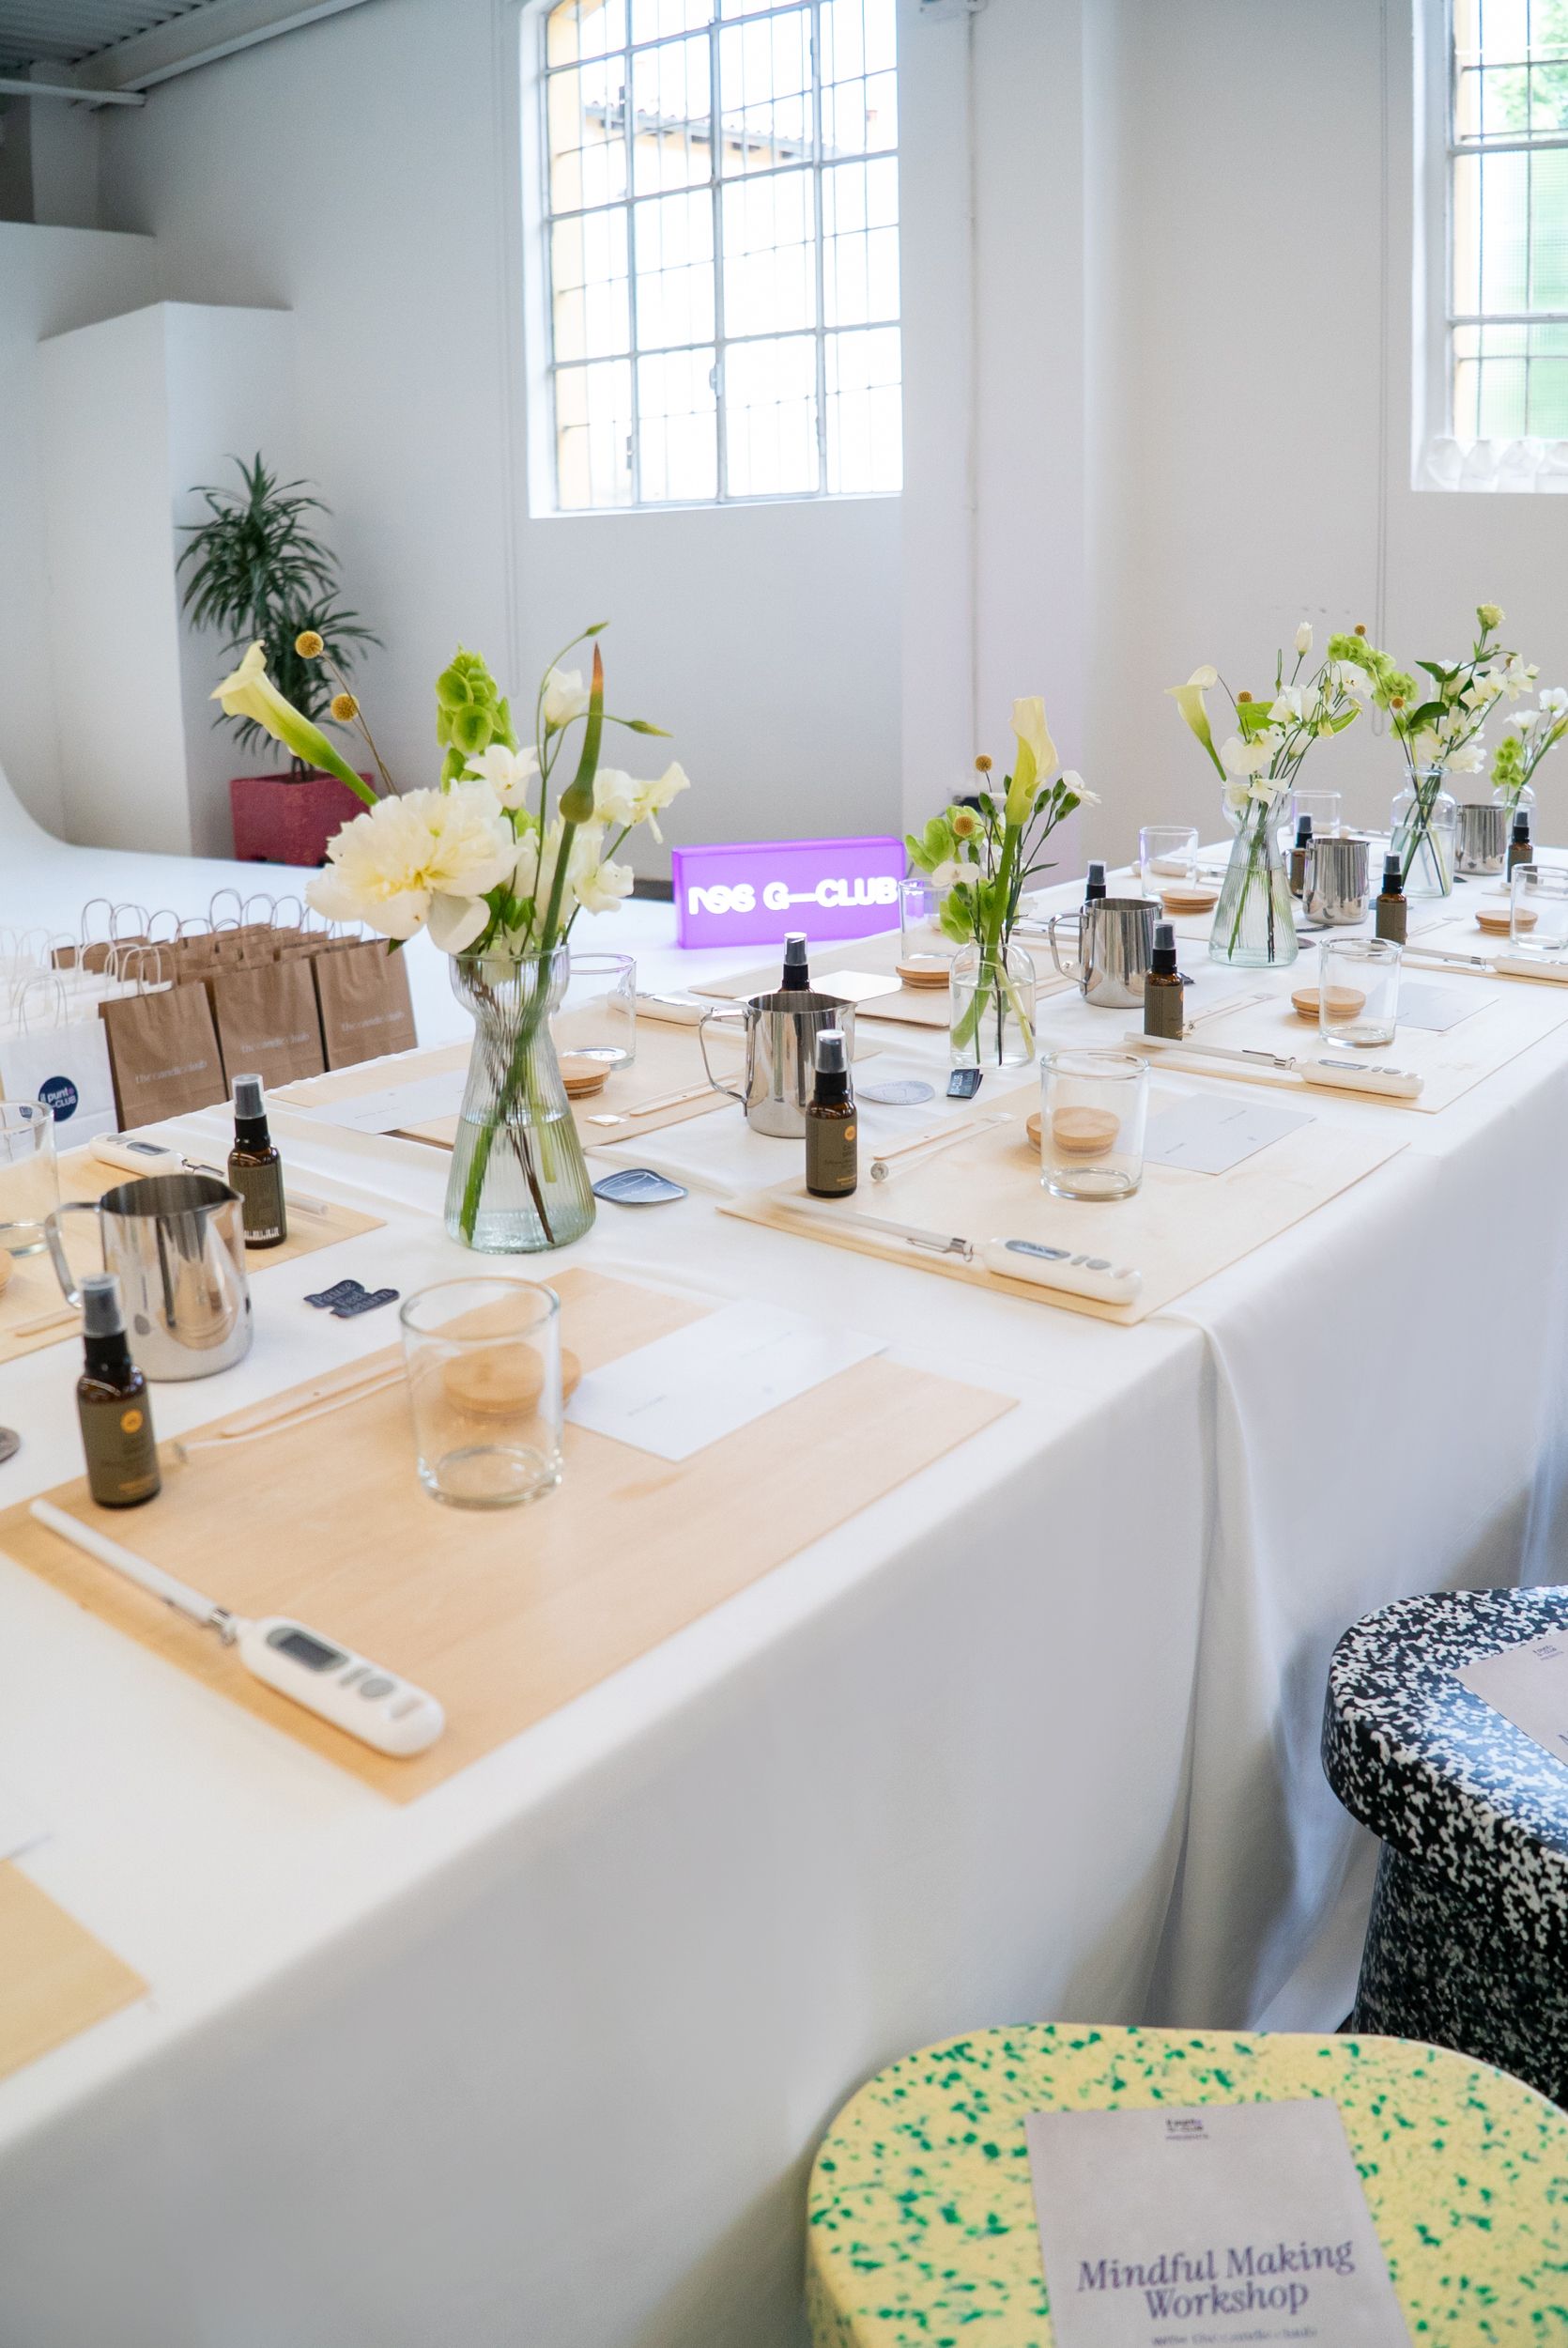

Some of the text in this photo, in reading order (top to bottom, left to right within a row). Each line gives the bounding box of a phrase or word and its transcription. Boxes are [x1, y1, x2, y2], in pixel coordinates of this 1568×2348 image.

[1077, 2240, 1356, 2293] Mindful Making
[1145, 2279, 1309, 2320] Workshop
